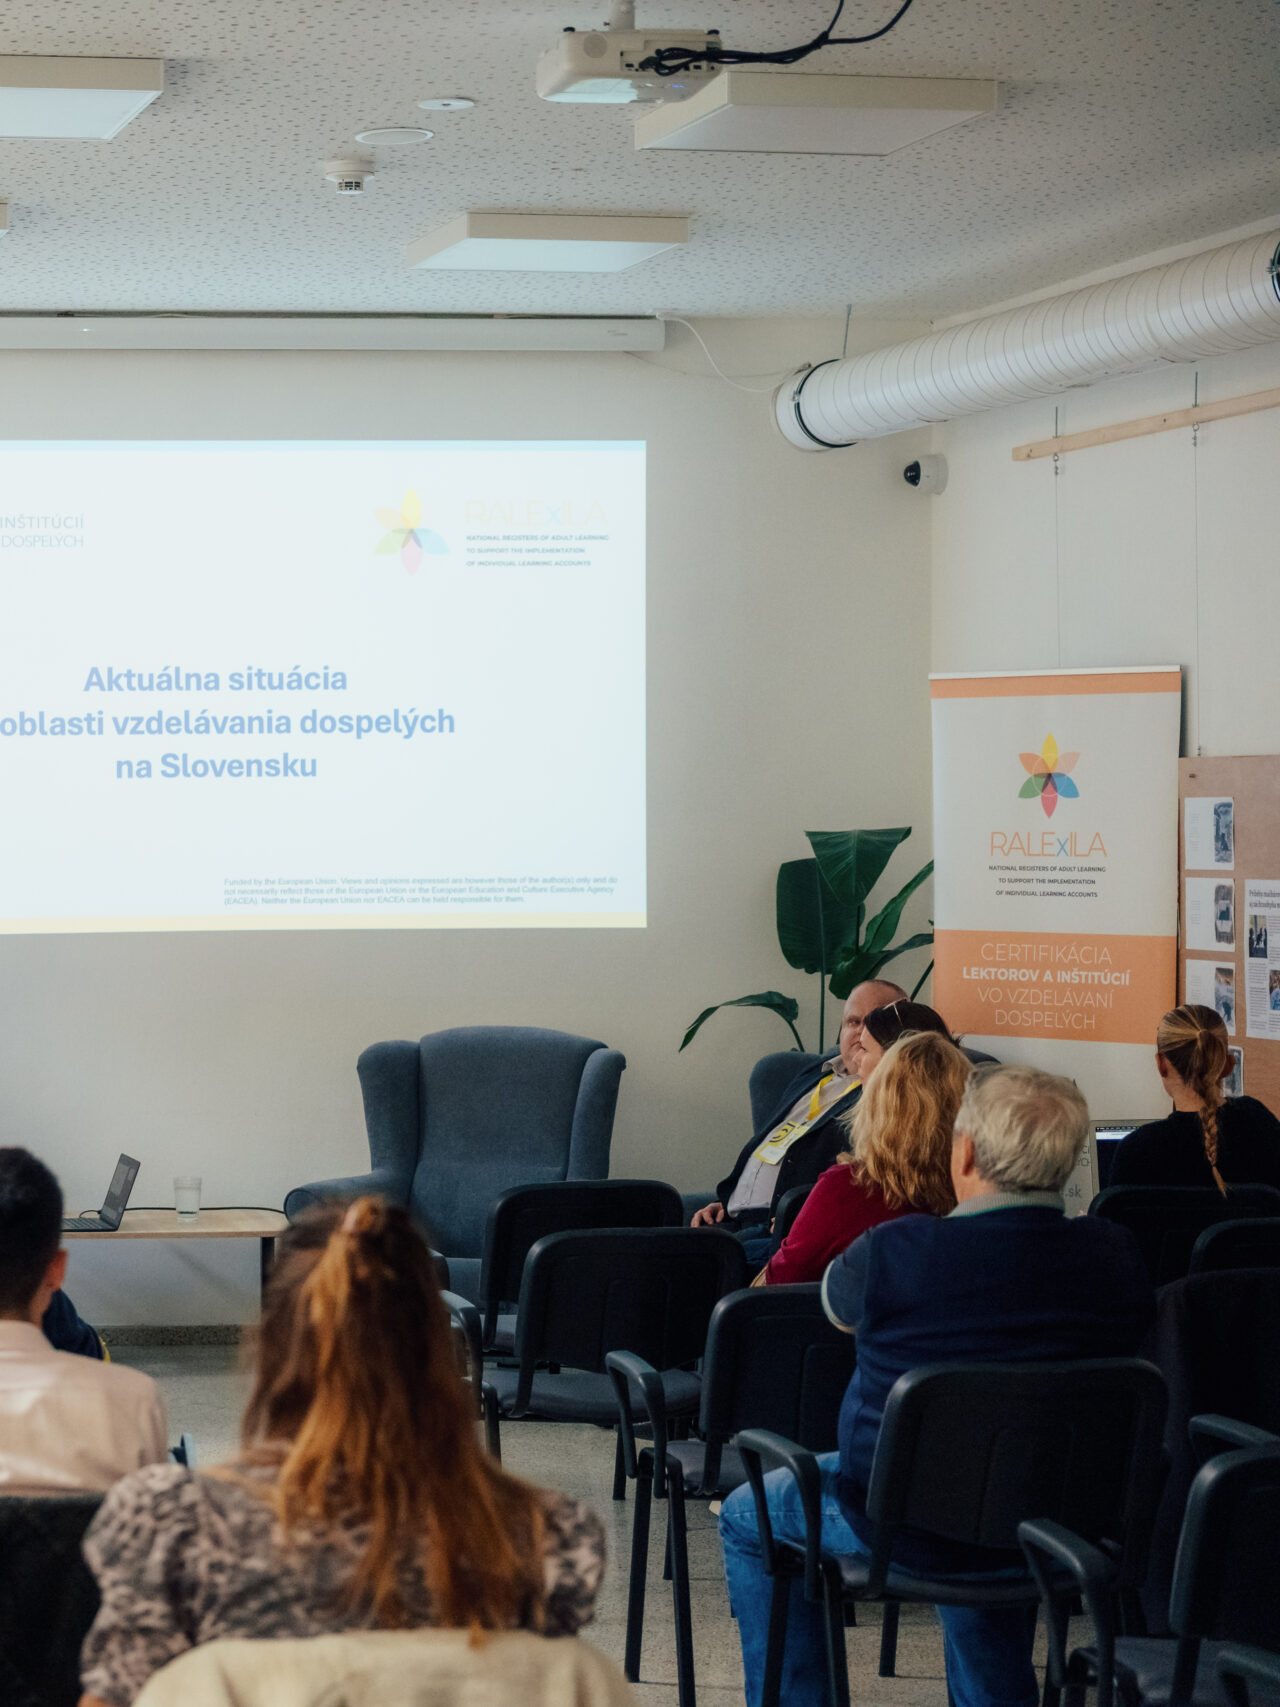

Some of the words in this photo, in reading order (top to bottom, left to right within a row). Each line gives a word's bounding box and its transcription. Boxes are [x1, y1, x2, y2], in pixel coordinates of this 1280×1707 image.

[0, 513, 85, 529] INŠTITÚCIÍ
[1, 531, 85, 548] DOSPELÝCH
[83, 666, 220, 692] Aktuálna
[228, 665, 348, 691] situácia
[112, 708, 292, 735] vzdelávania
[300, 707, 456, 740] dospelých
[116, 758, 152, 778] na
[160, 752, 318, 778] Slovensku
[980, 942, 1112, 965] CERTIFIKÁCIA
[962, 967, 1040, 982] LEKTOROV
[1043, 969, 1054, 982] A
[1057, 967, 1130, 986] INŠTITÚCIÍ
[977, 987, 1003, 1004] VO
[1007, 988, 1114, 1008] VZDELÁVANÍ
[995, 1010, 1096, 1030] DOSPELÝCH
